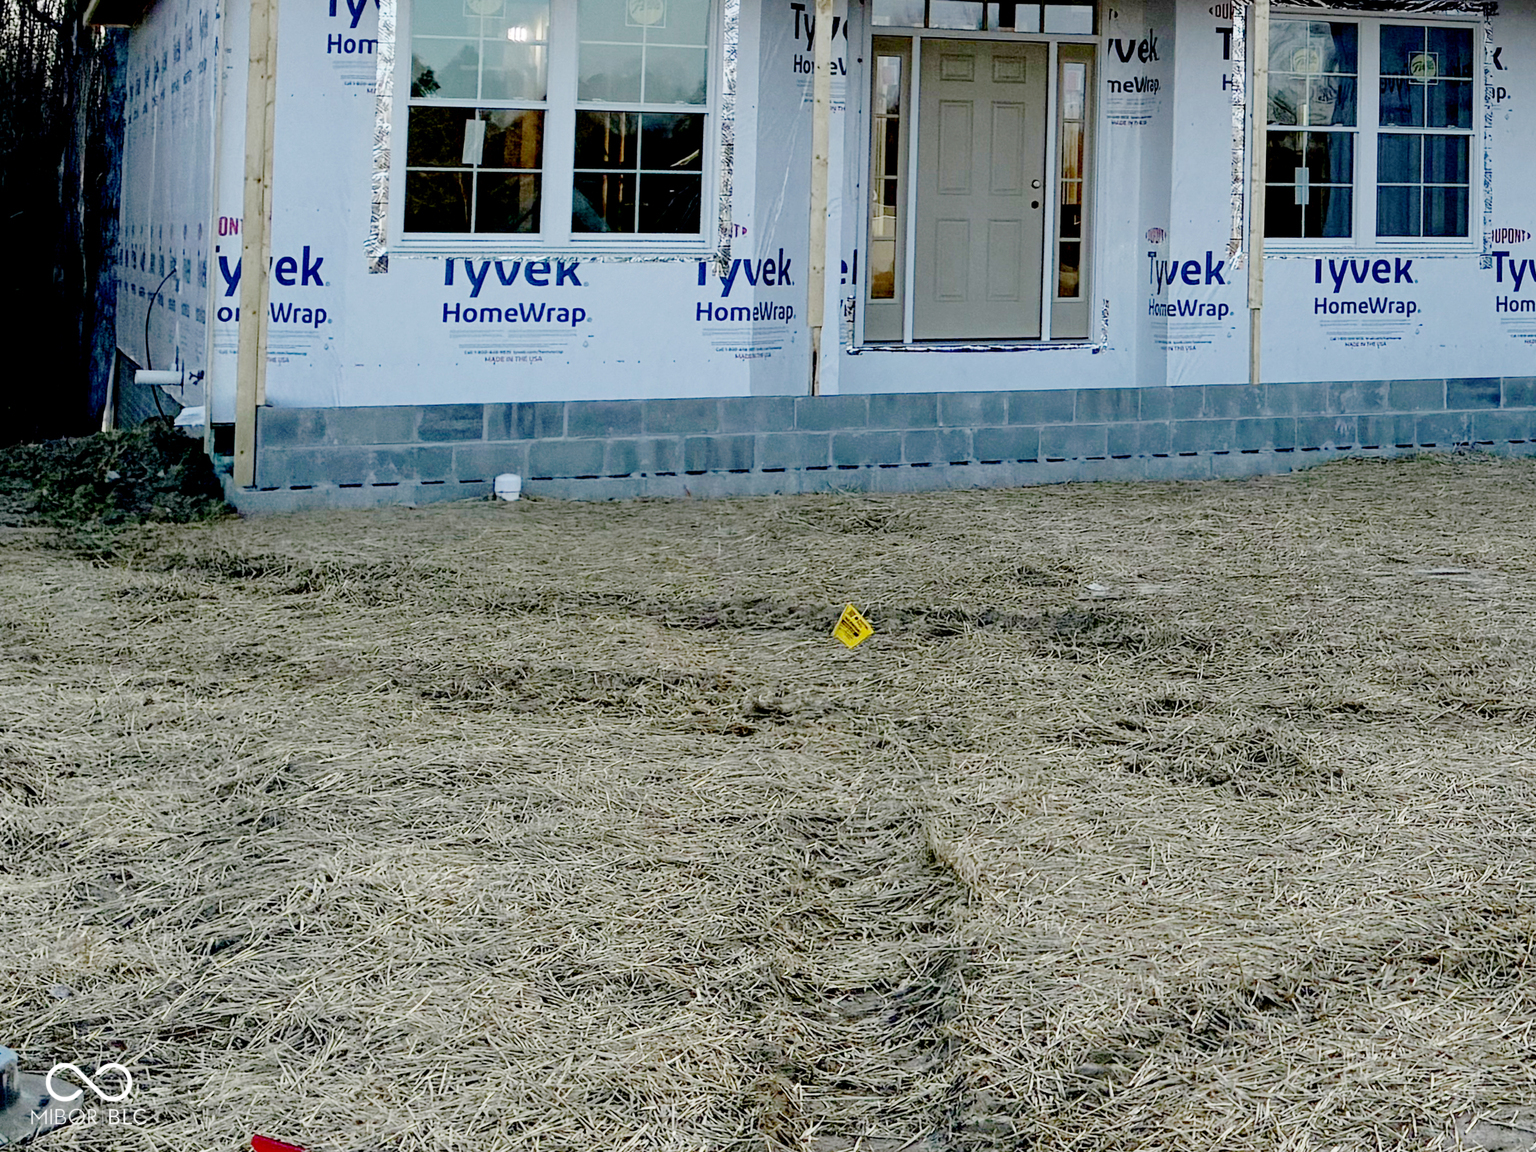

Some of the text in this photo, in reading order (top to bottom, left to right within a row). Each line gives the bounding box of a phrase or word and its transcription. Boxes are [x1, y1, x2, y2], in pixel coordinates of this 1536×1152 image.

[1148, 250, 1226, 295] Tyvek
[442, 302, 586, 327] HomeWrap
[696, 301, 794, 324] HomeWrap
[1149, 299, 1229, 320] HomeWrap
[1314, 297, 1417, 317] HomeWrap
